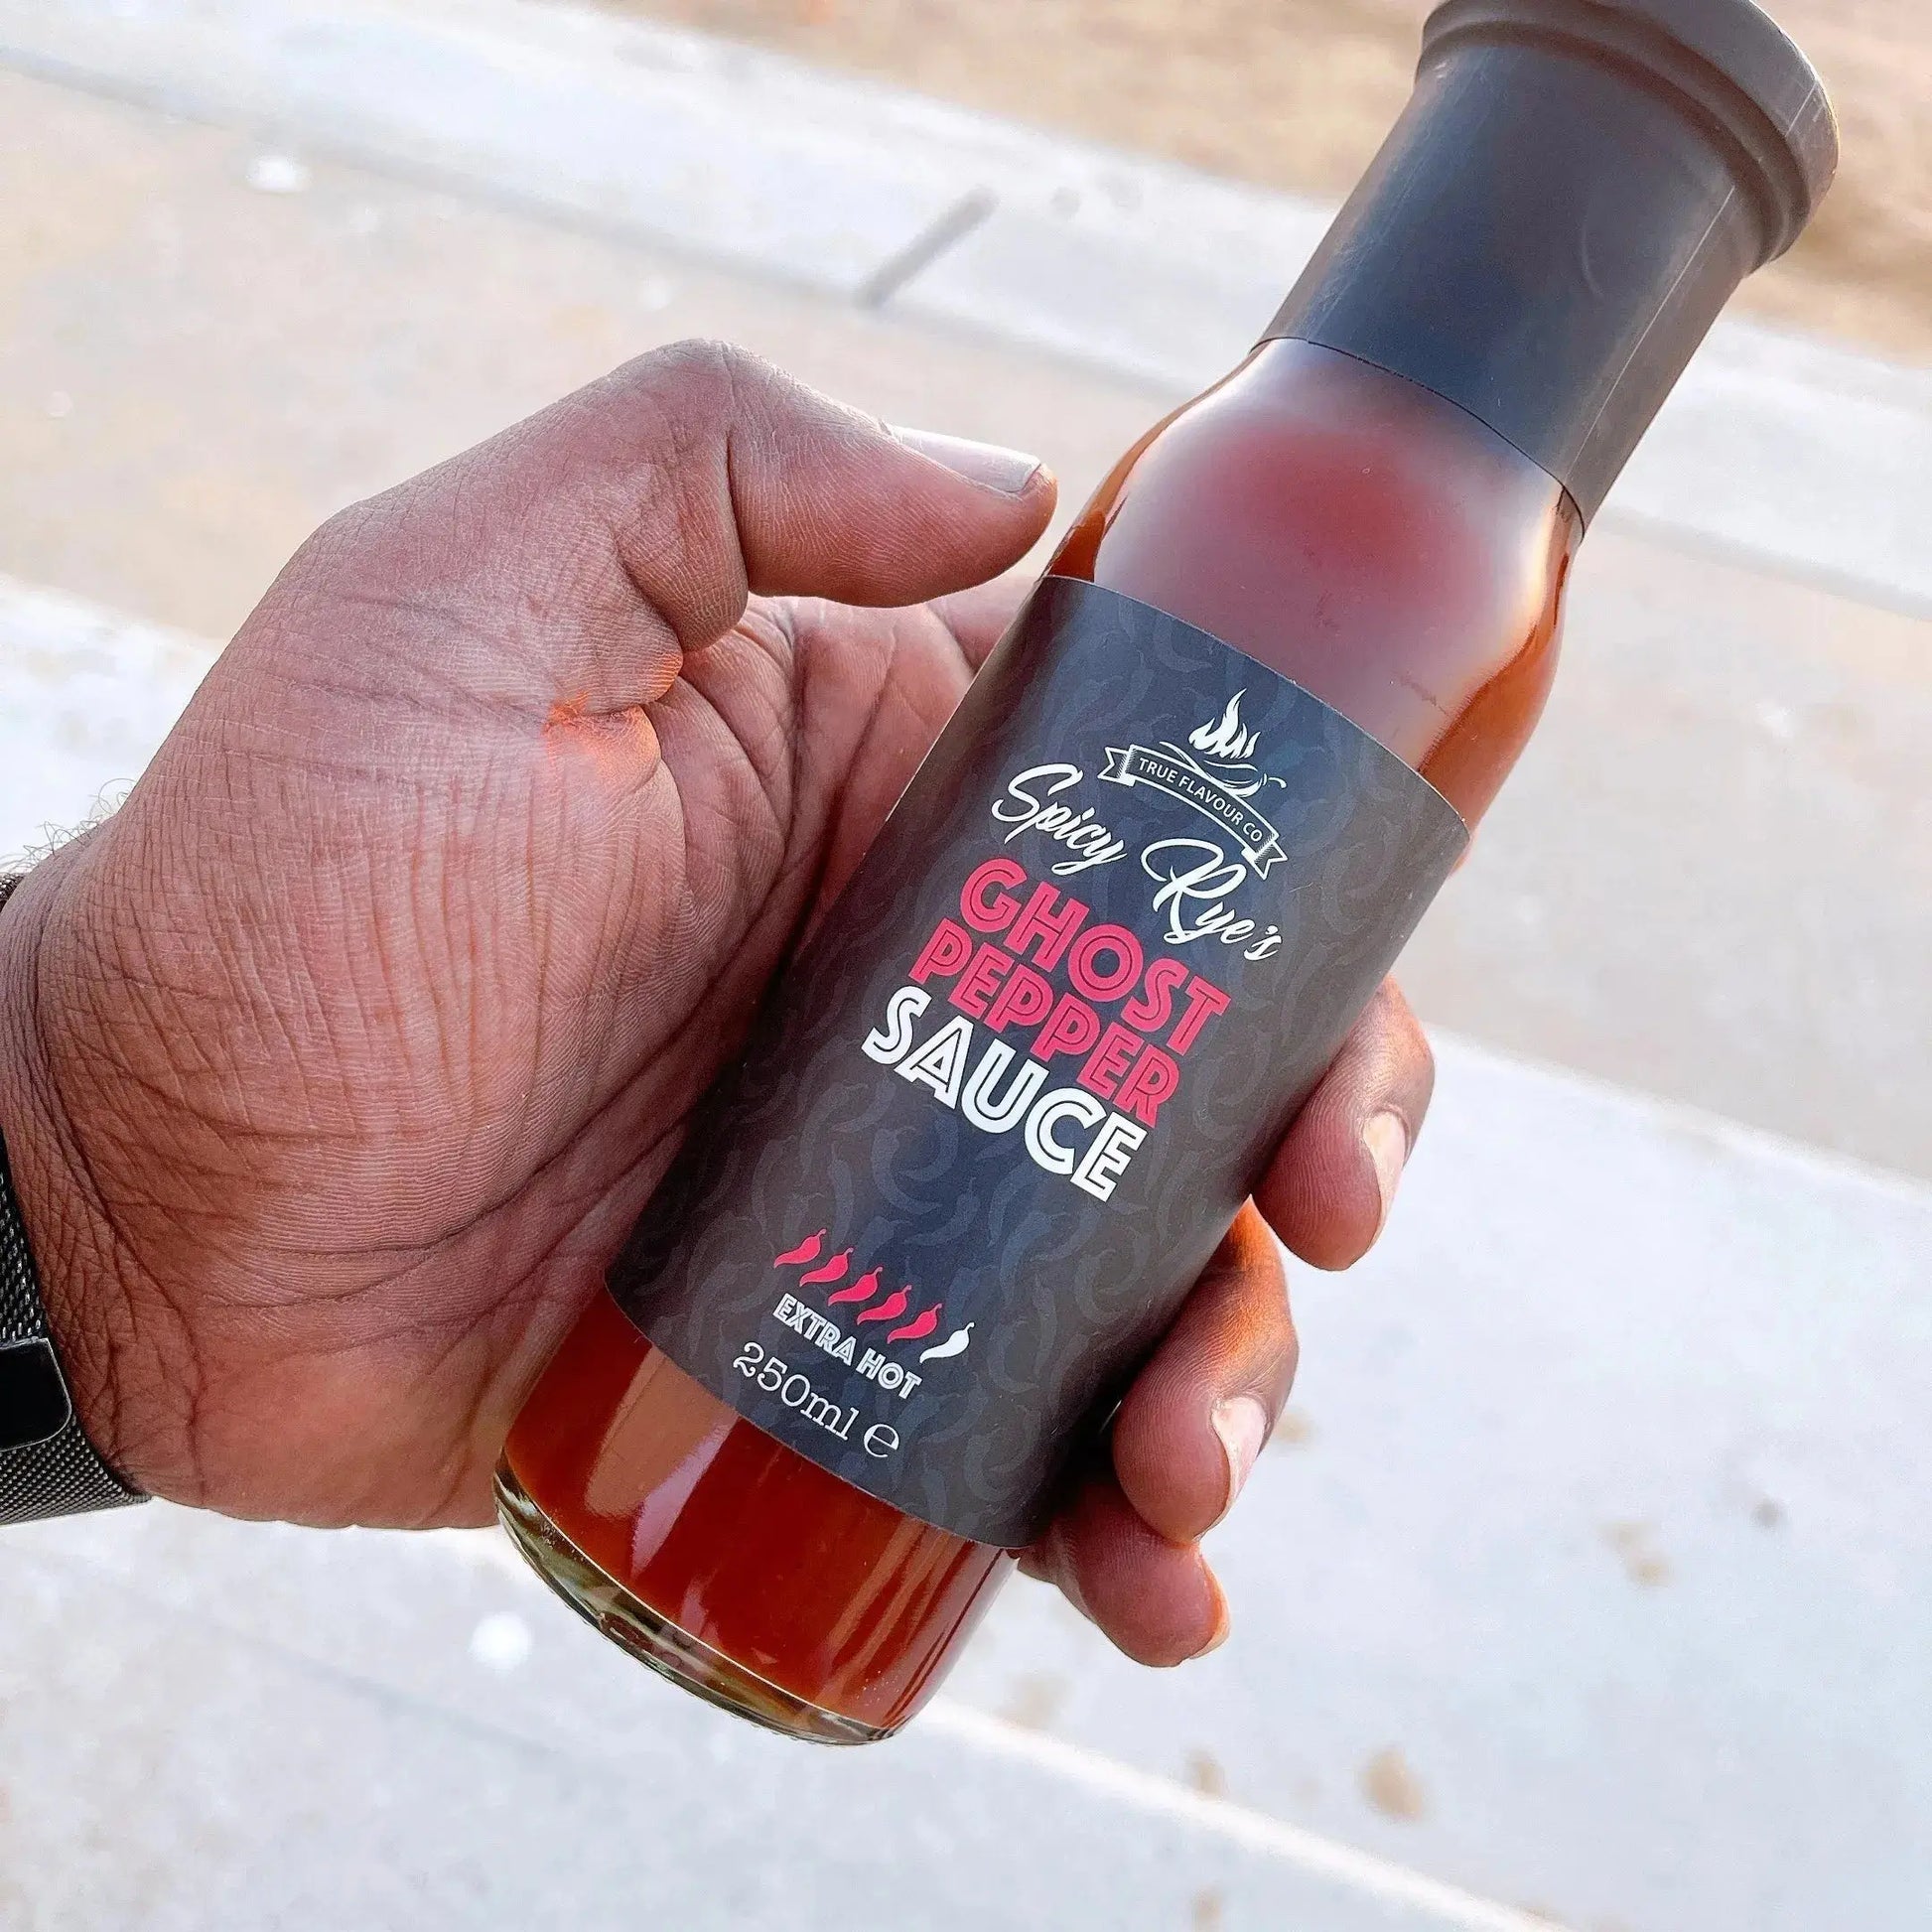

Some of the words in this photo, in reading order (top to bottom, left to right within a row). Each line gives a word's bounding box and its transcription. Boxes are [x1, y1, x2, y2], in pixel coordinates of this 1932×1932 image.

[992, 763, 1128, 876] Spicy
[1141, 838, 1282, 961] Rye's
[1139, 757, 1177, 783] TRUE
[1178, 772, 1244, 823] FLAVOUR
[1243, 821, 1263, 842] CO
[908, 918, 1179, 1128] PEPPER
[960, 858, 1231, 1056] GHOST
[861, 985, 1148, 1202] SAUCE
[733, 1341, 860, 1441] 250ml
[772, 1293, 858, 1366] EXTRA
[856, 1347, 922, 1399] HOT
